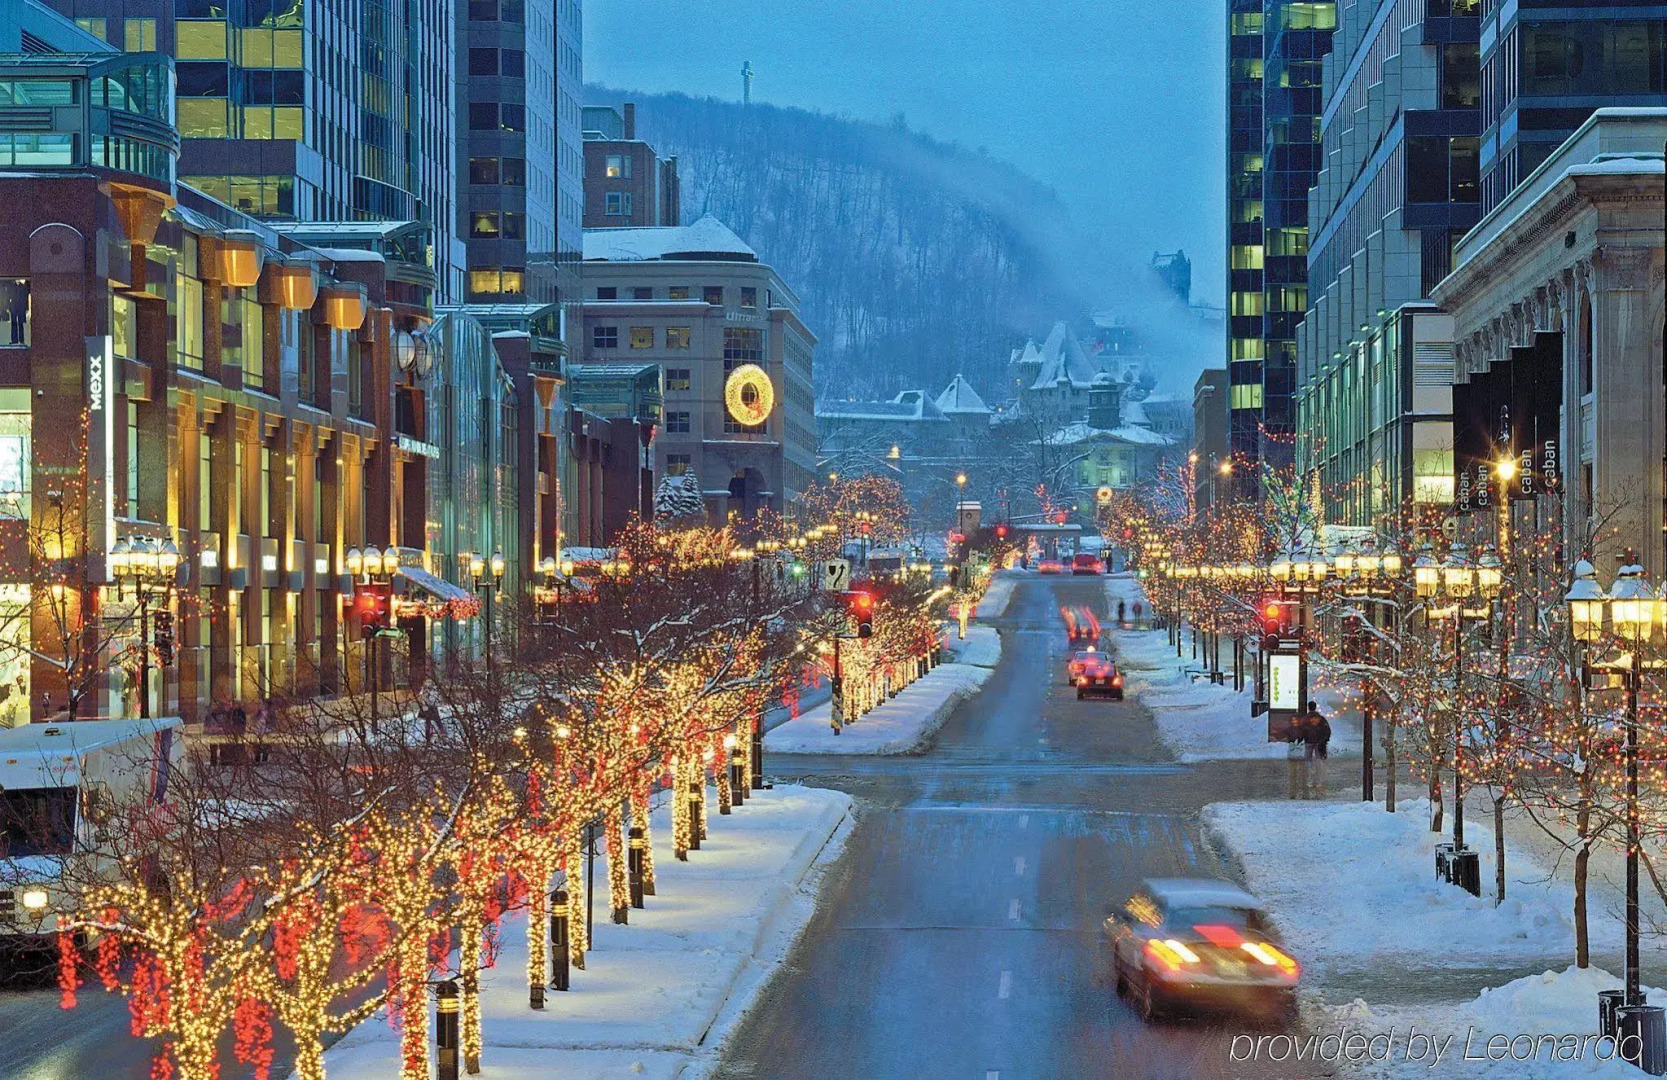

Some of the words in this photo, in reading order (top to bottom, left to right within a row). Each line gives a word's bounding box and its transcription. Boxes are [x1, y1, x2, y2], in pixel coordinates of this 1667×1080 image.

[1477, 465, 1488, 506] caban
[1520, 449, 1532, 494] caban
[1542, 440, 1556, 488] caban
[1459, 472, 1469, 511] caban
